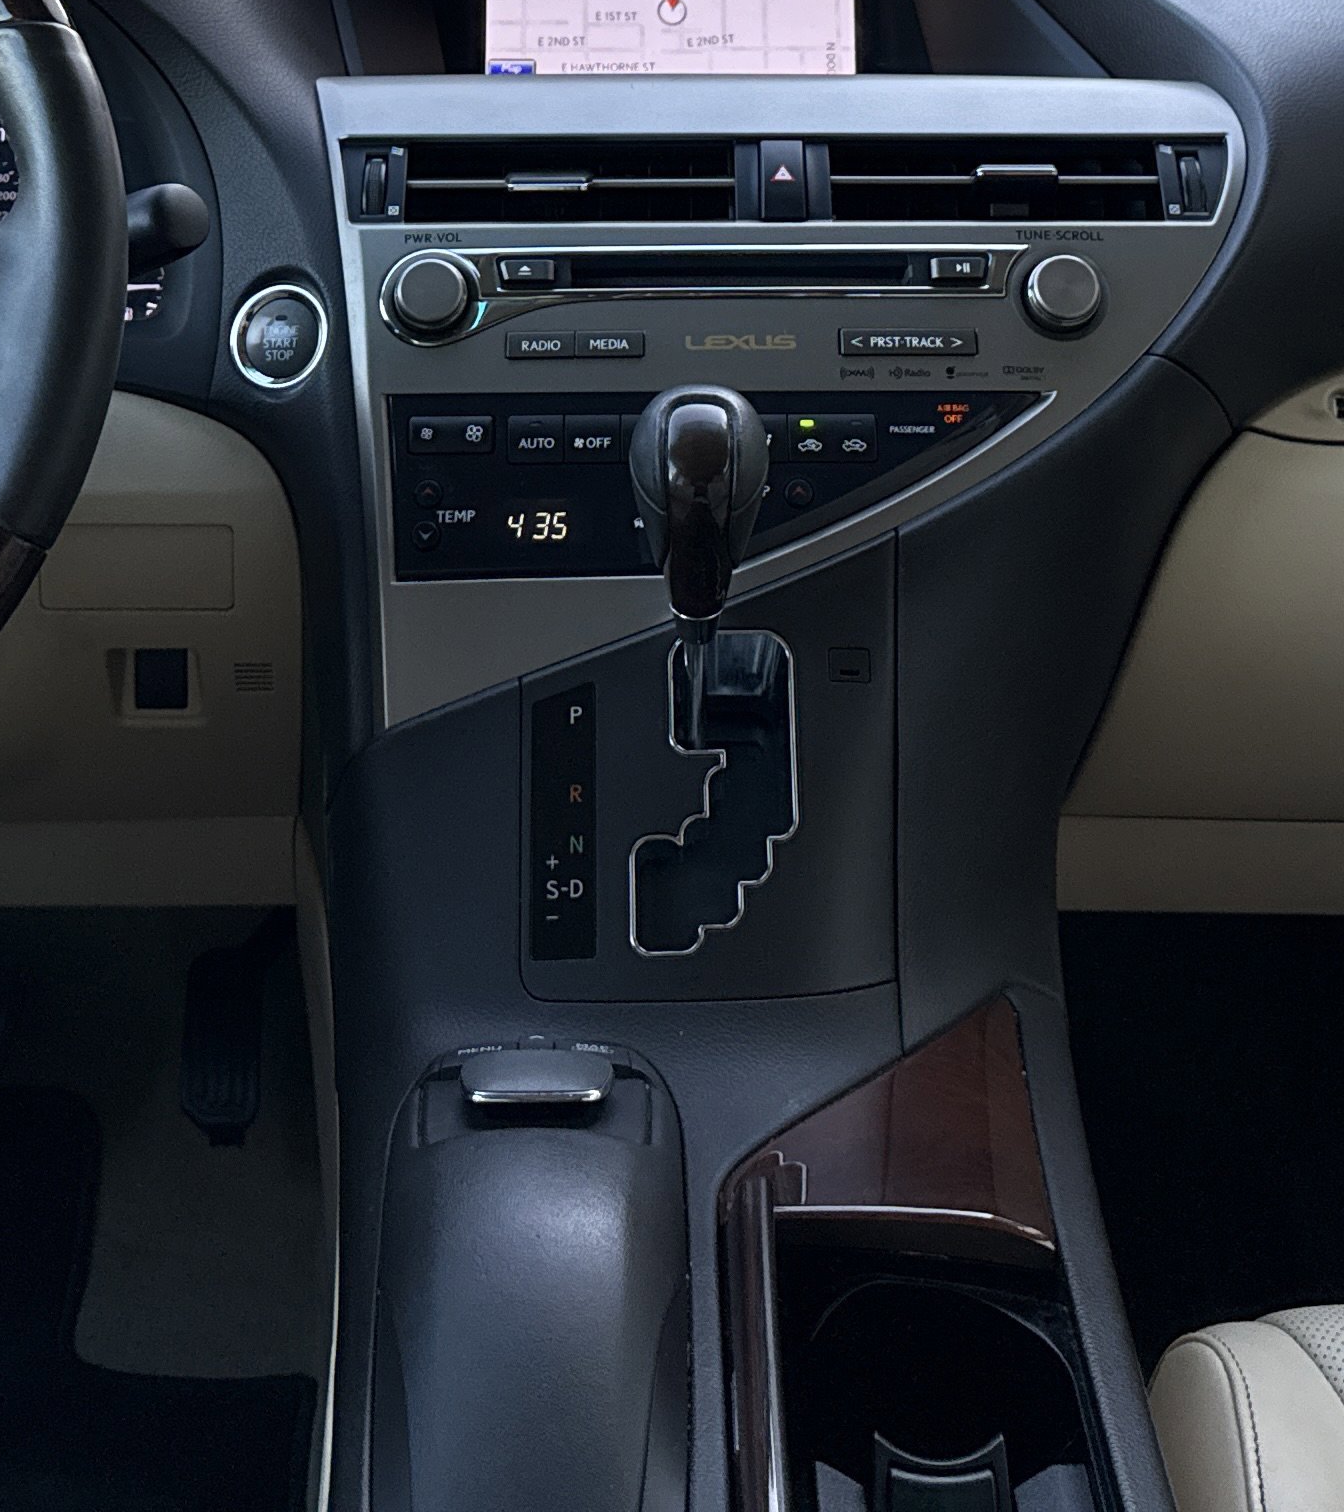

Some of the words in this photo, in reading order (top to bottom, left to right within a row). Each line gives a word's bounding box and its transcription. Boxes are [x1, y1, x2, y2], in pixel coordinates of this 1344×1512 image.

[625, 11, 638, 21] ST
[547, 36, 570, 47] 2ND
[573, 36, 586, 46] ST
[697, 35, 719, 47] 2ND
[722, 34, 734, 44] ST
[570, 63, 639, 73] HAWTHORNE
[643, 62, 656, 72] ST
[521, 339, 561, 352] RADIO
[589, 338, 630, 350] MEDIA
[683, 332, 798, 352] LEXUS
[264, 350, 295, 362] STOP
[944, 415, 964, 425] OFF
[889, 425, 936, 435] PASSENGER
[518, 437, 555, 450] AUTO
[586, 437, 612, 450] OFF
[436, 509, 476, 524] TEMP
[569, 706, 583, 725] P
[569, 784, 583, 803] R
[570, 835, 584, 854] N
